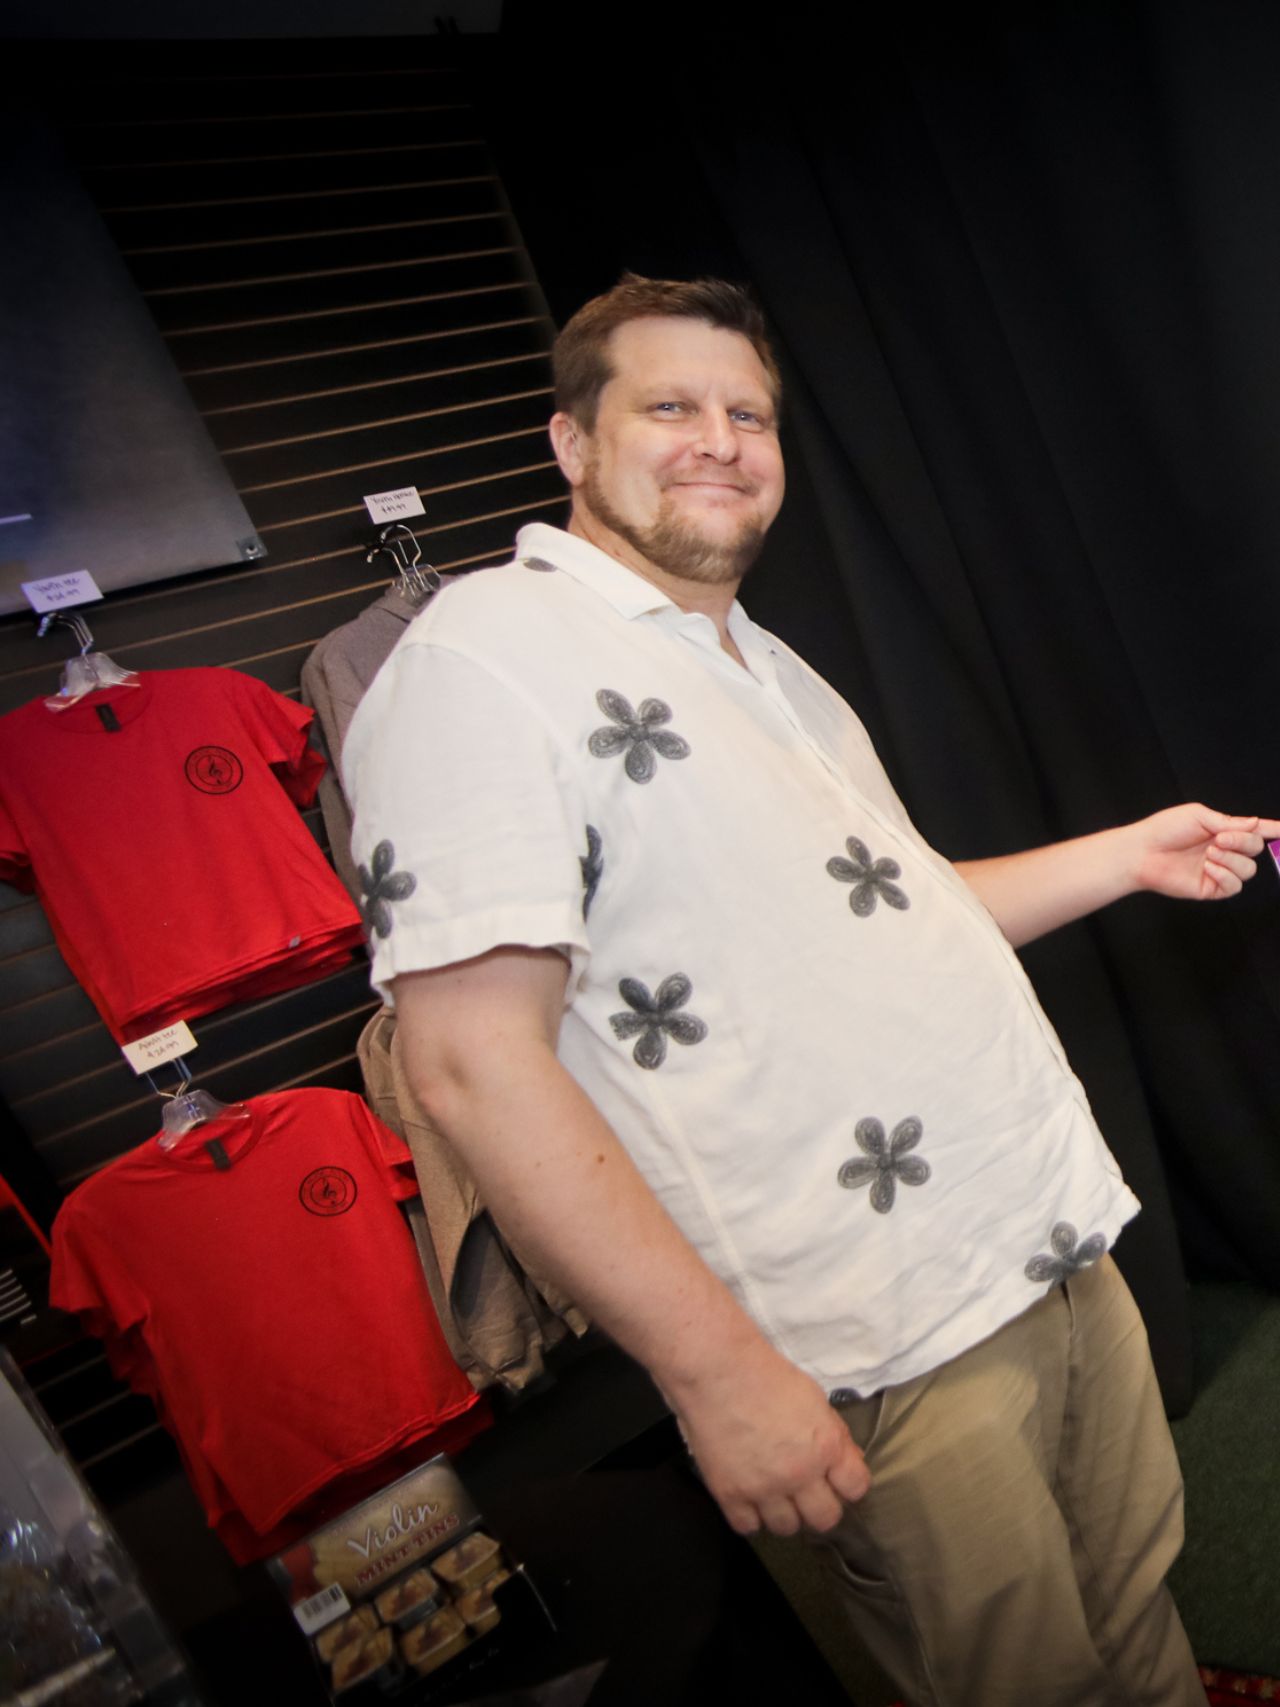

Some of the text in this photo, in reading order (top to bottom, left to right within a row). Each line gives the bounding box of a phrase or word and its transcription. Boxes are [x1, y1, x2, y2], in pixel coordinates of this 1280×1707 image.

[347, 1500, 438, 1558] Violin
[357, 1513, 460, 1585] MINT TINS
